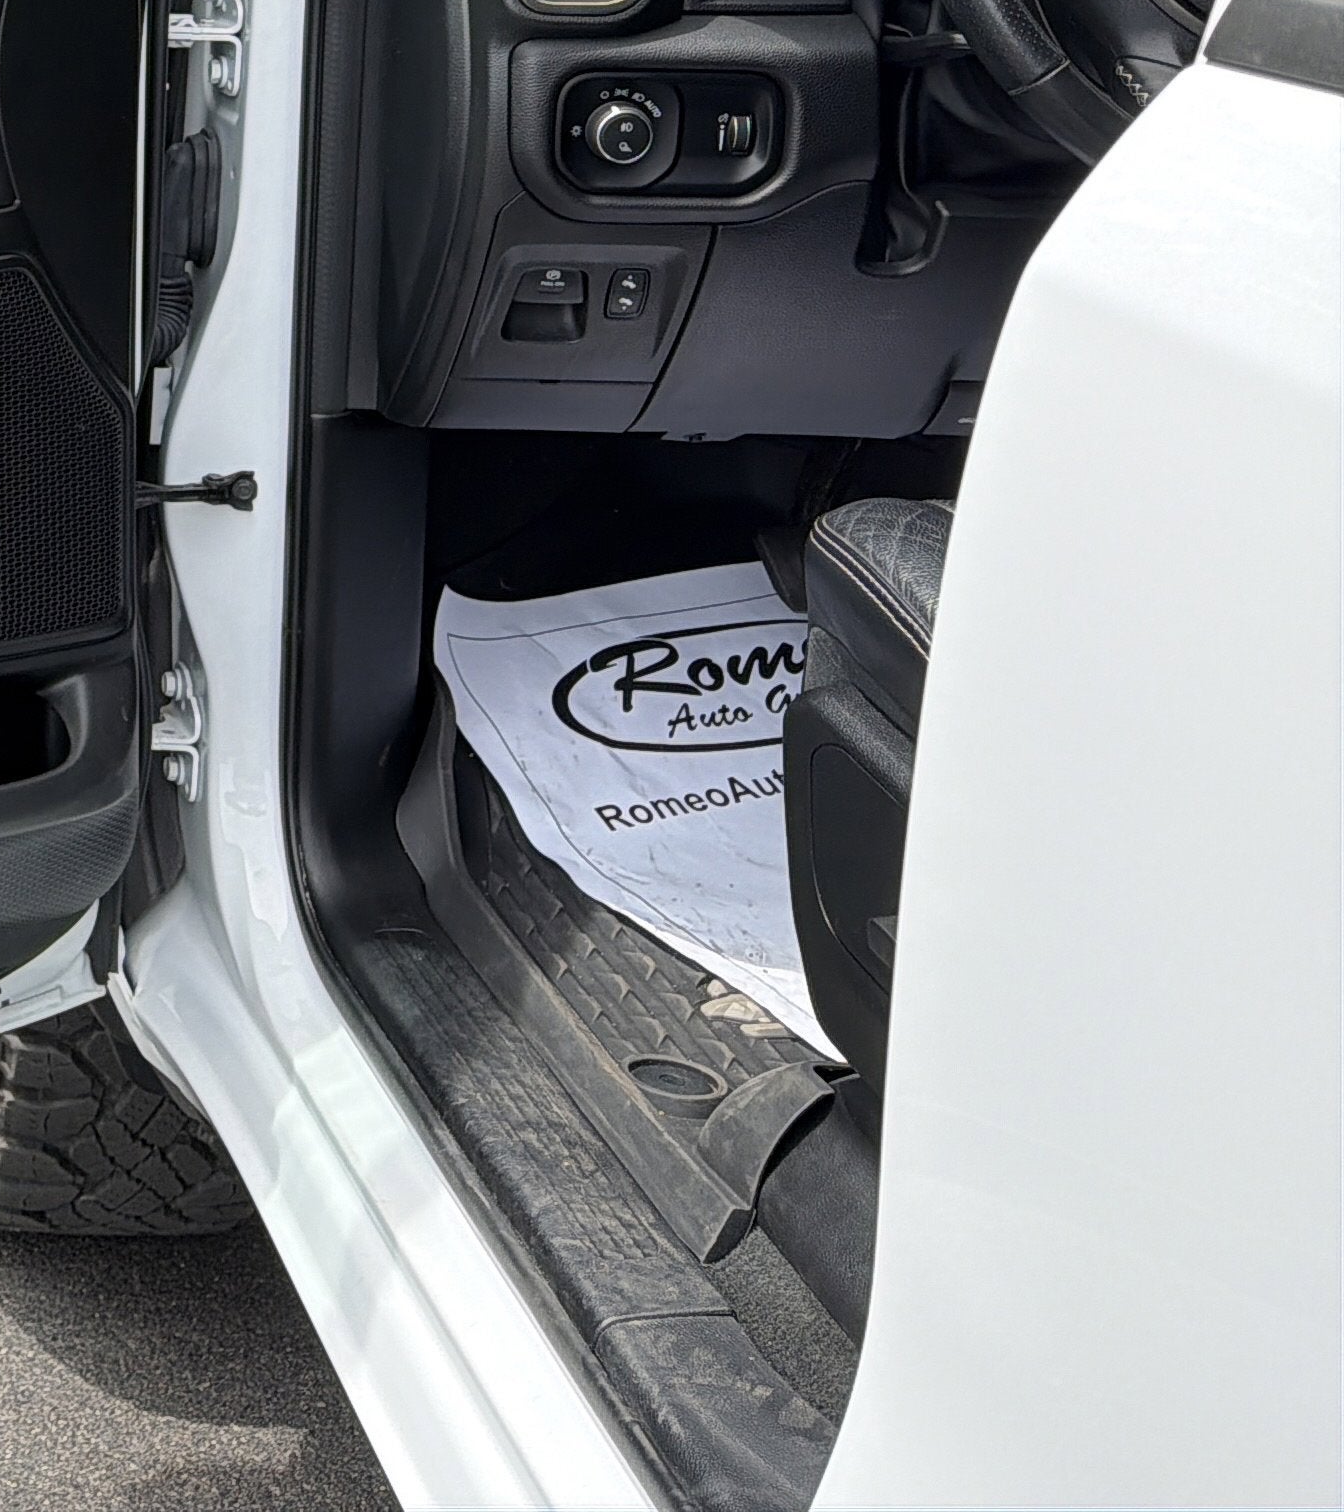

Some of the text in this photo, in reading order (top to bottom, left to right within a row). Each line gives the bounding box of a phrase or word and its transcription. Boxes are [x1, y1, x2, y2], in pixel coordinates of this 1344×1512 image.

[644, 100, 662, 118] AUTO
[590, 639, 809, 713] Rom
[667, 702, 753, 738] Auto
